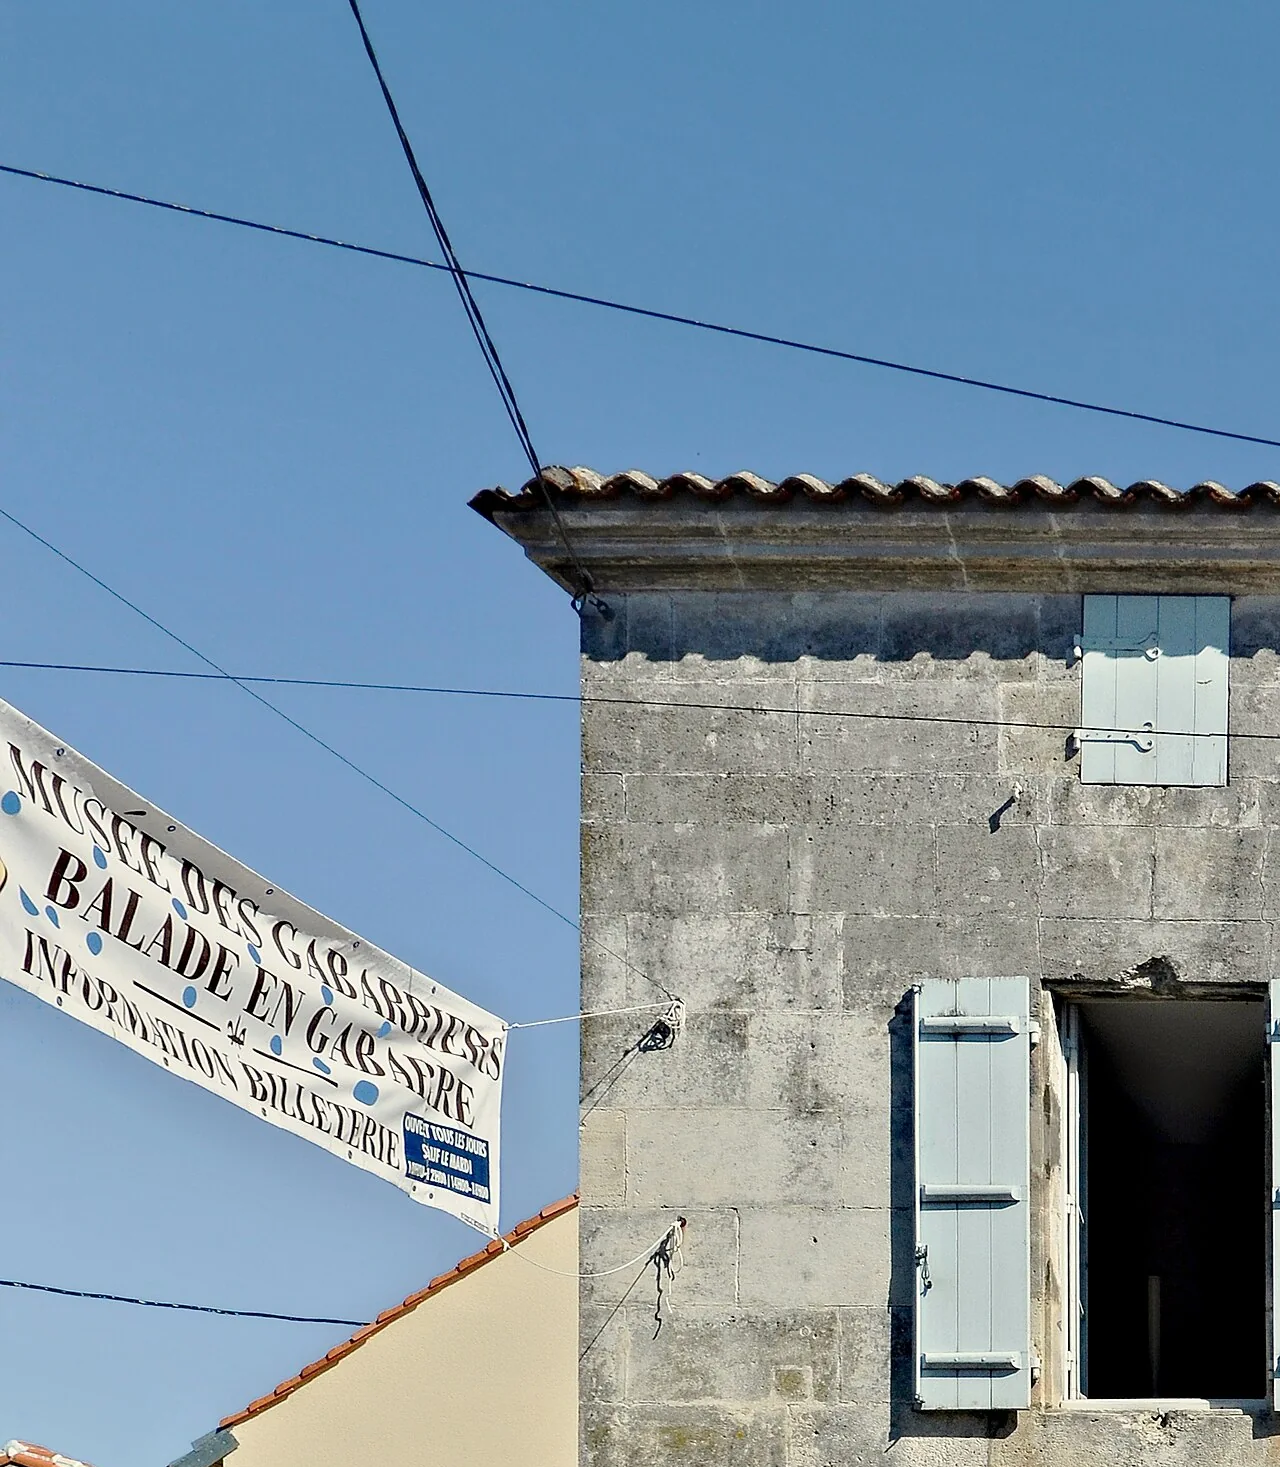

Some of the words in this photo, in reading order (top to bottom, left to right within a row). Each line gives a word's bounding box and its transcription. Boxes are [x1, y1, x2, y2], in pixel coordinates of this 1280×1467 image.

[7, 741, 171, 894] MUSÉE
[181, 858, 263, 948] DES
[272, 920, 502, 1081] GABARRIERS
[44, 847, 240, 1001] BALADE
[243, 964, 306, 1036] EN
[21, 927, 238, 1091] INFORMATION
[239, 1061, 400, 1170] BILLETERIE
[430, 1125, 454, 1145] TOUS
[455, 1132, 465, 1149] LES
[441, 1150, 449, 1166] LE
